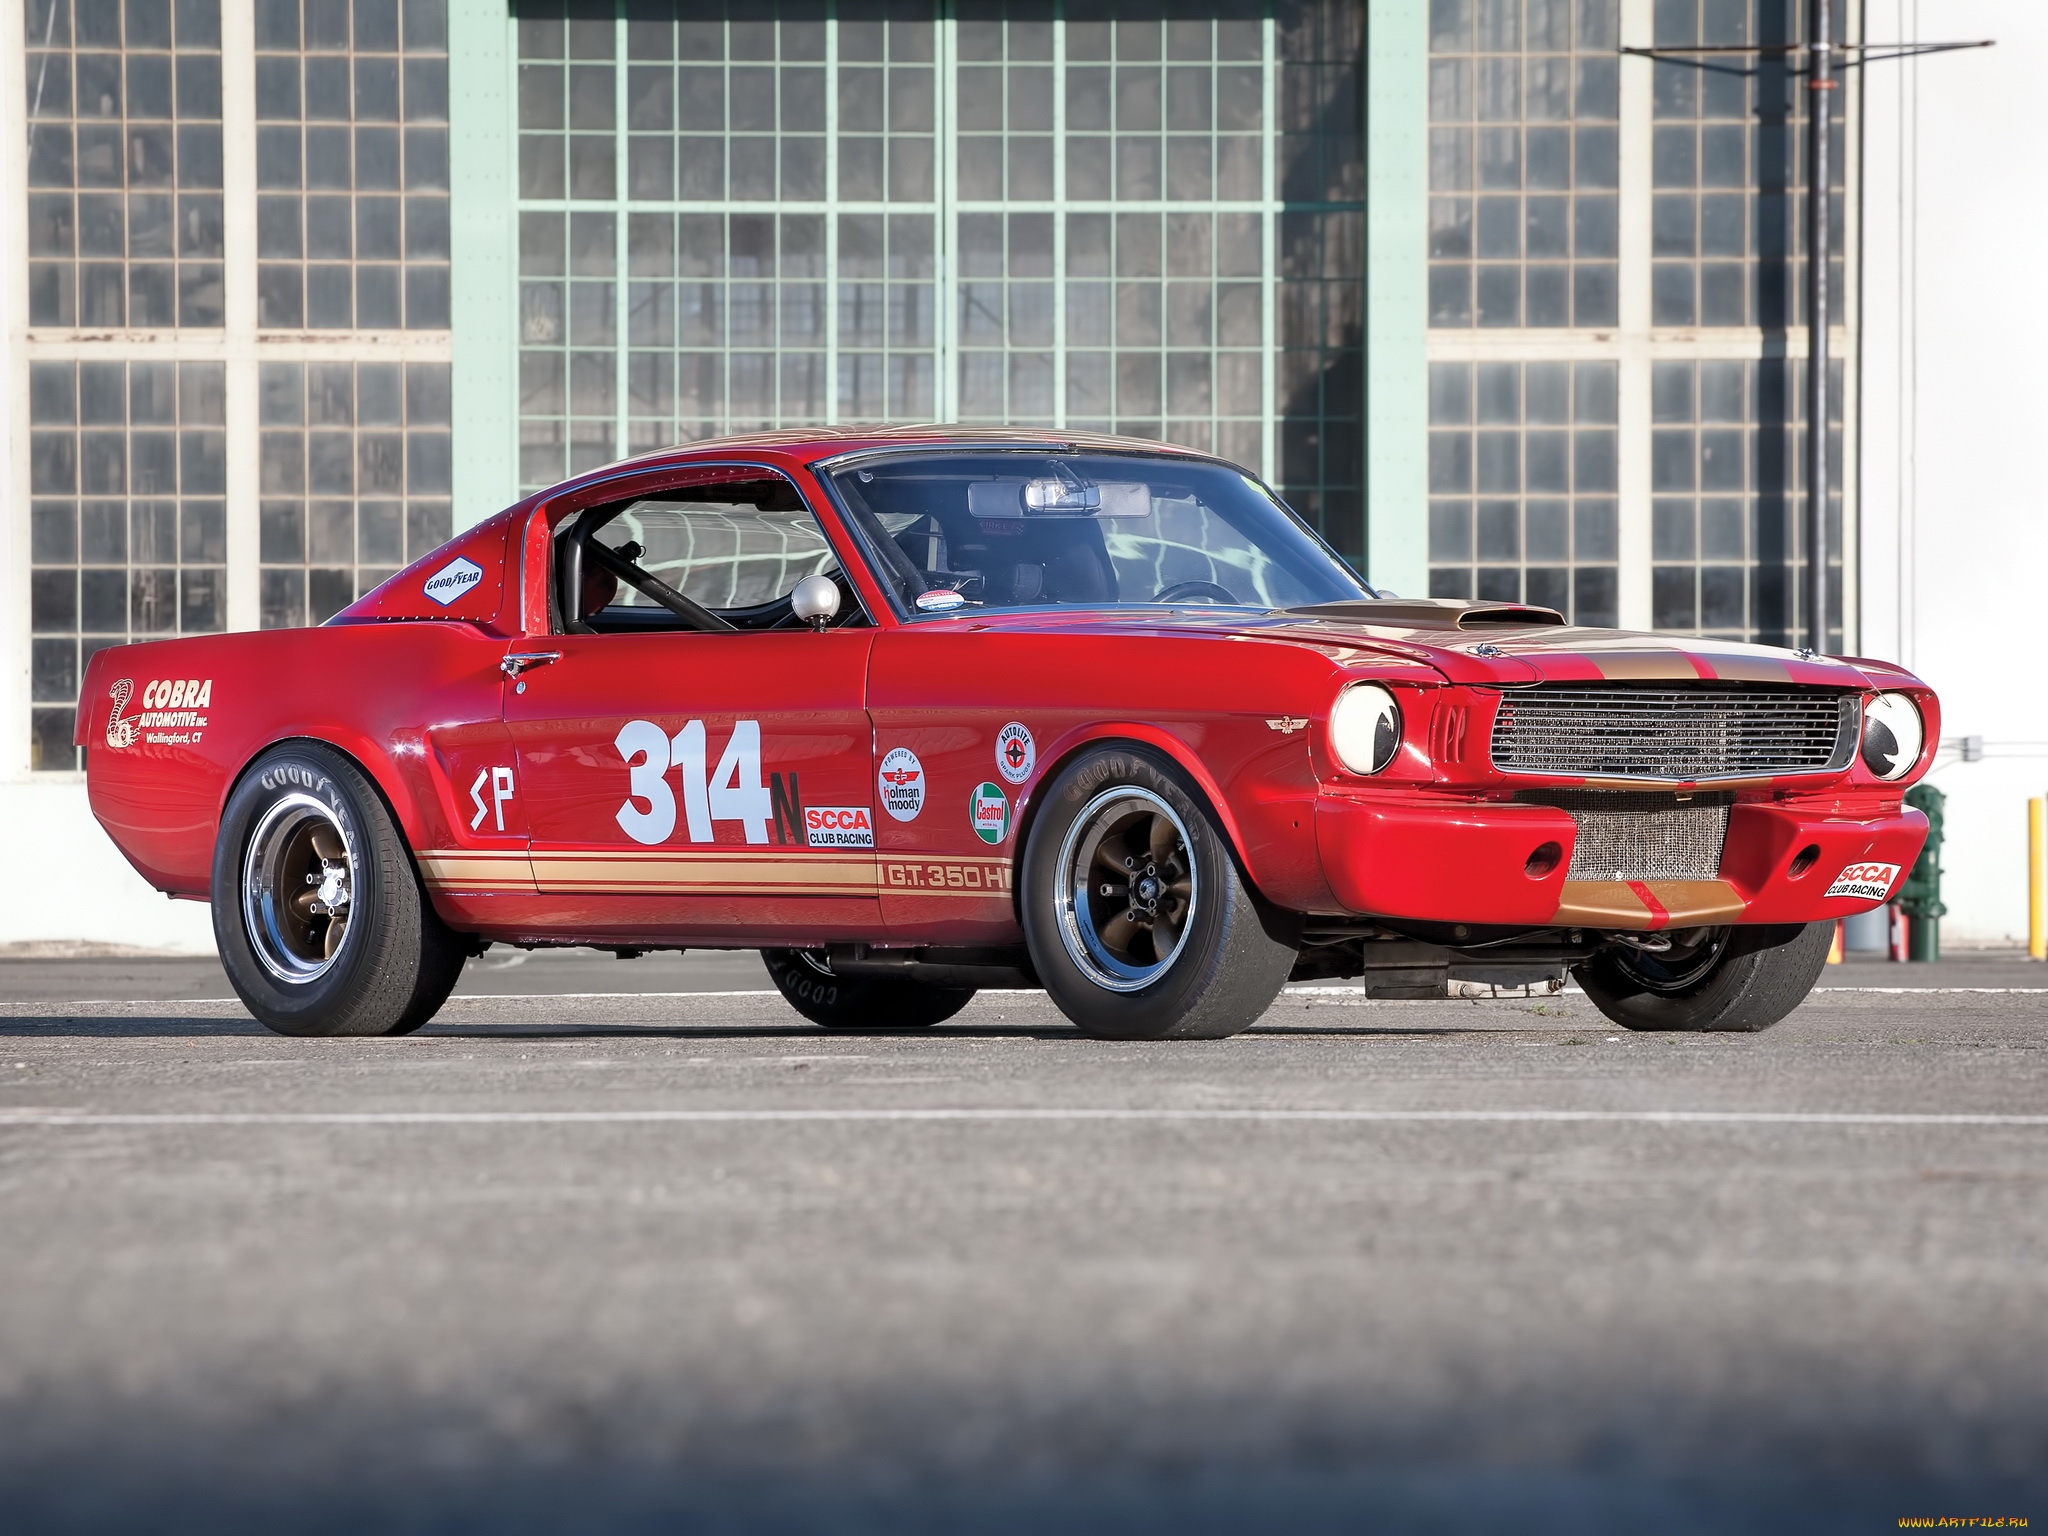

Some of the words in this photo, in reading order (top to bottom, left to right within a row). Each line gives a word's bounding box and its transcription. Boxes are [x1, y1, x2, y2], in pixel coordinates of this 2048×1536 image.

[427, 572, 480, 590] GOODYEAR
[142, 679, 212, 709] COBRA
[138, 711, 198, 728] AUTOMOTIVE
[146, 732, 190, 746] Wallingford,
[191, 732, 203, 743] CT
[1001, 726, 1031, 746] AUTOLITE
[884, 750, 908, 767] POWERED
[908, 755, 916, 765] BY
[614, 719, 773, 845] 314
[770, 772, 805, 844] N
[883, 785, 920, 801] holman
[888, 798, 920, 811] moody
[976, 799, 1004, 820] Castrol
[806, 810, 870, 830] SCCA
[810, 833, 835, 844] CLUB
[836, 833, 873, 845] RACING
[888, 864, 925, 886] G.T.
[927, 865, 981, 888] 350
[1837, 865, 1892, 885] SCCA
[1827, 884, 1848, 895] CLUB
[1848, 884, 1886, 898] RACING
